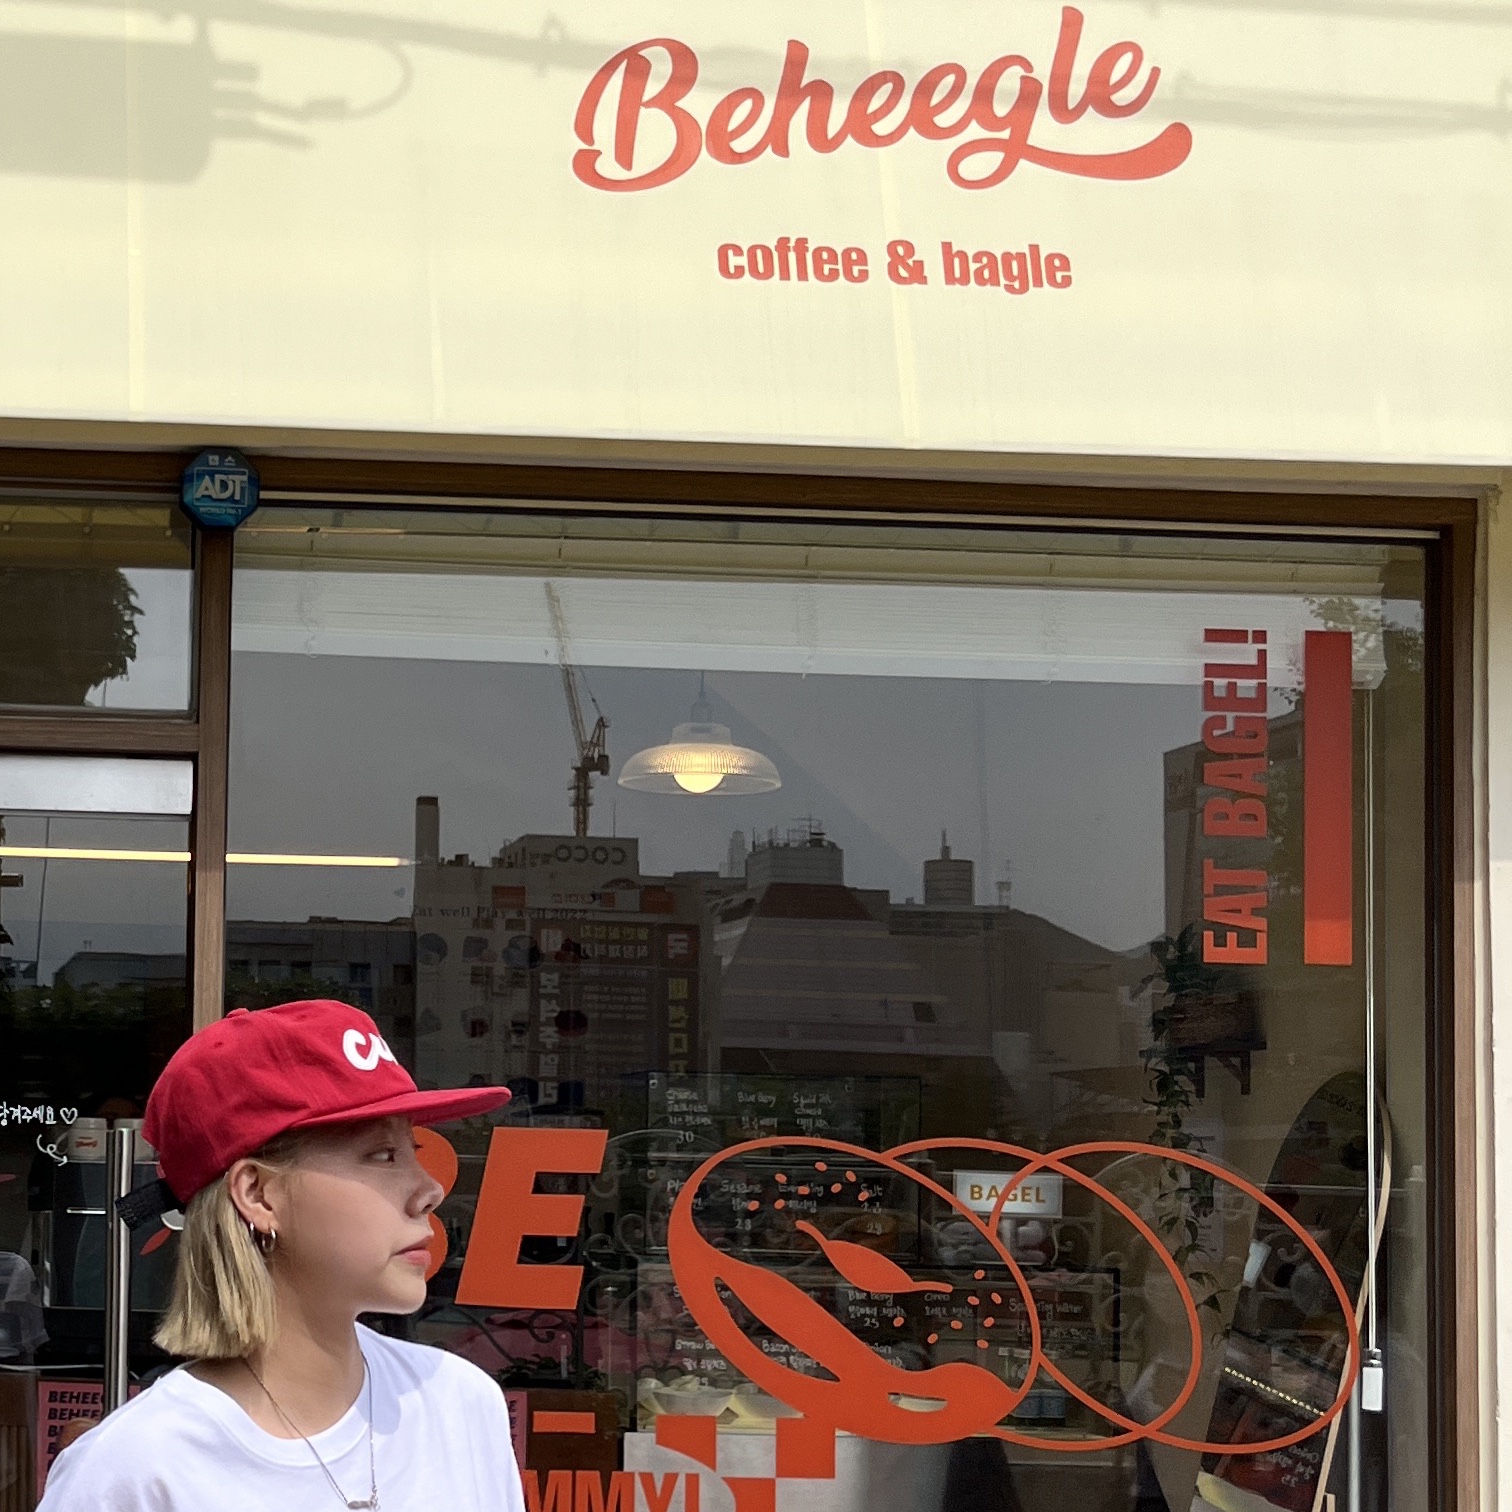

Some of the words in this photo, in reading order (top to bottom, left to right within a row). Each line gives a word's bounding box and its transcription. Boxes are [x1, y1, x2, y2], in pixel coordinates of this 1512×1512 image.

[573, 6, 1193, 192] Beheegle
[717, 237, 869, 283] coffee
[887, 240, 927, 285] &
[941, 241, 1073, 295] bagle
[194, 474, 248, 500] ADT
[1202, 628, 1270, 840] BAGEL!
[1202, 857, 1270, 967] EAT
[969, 1184, 1046, 1204] BAGEL
[47, 1390, 104, 1405] BEHEE
